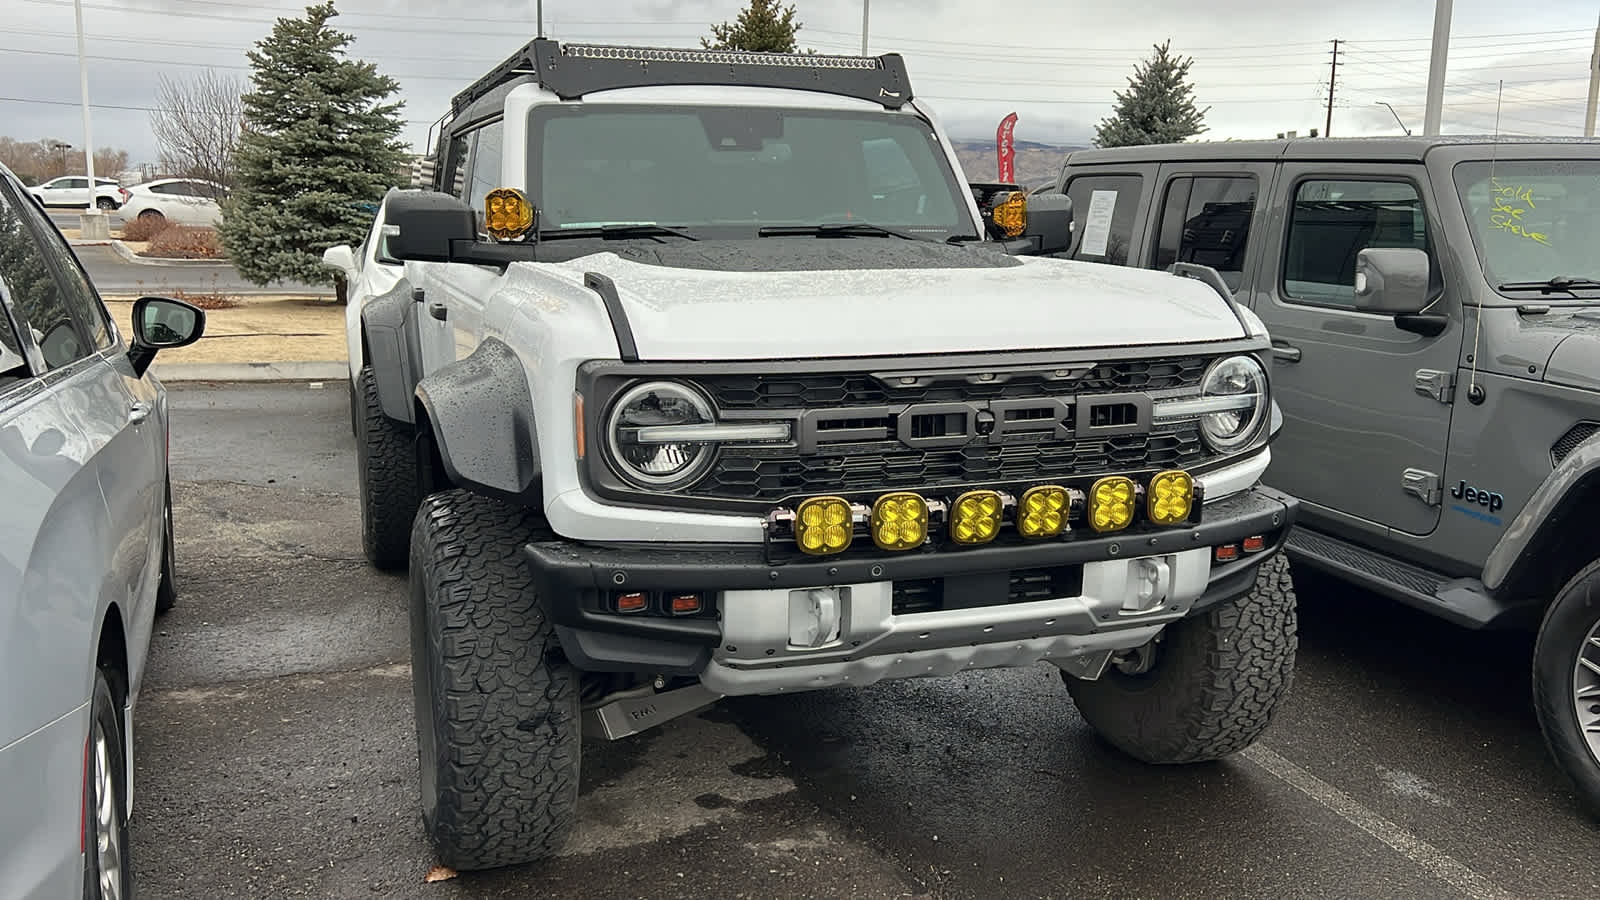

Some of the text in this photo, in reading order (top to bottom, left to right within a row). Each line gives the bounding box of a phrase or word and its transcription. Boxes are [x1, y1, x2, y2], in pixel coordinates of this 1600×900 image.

[1491, 176, 1536, 208] Sold
[1491, 197, 1525, 221] See
[1489, 215, 1552, 247] Steve
[800, 391, 1154, 454] FORD
[1451, 479, 1503, 512] Jeep
